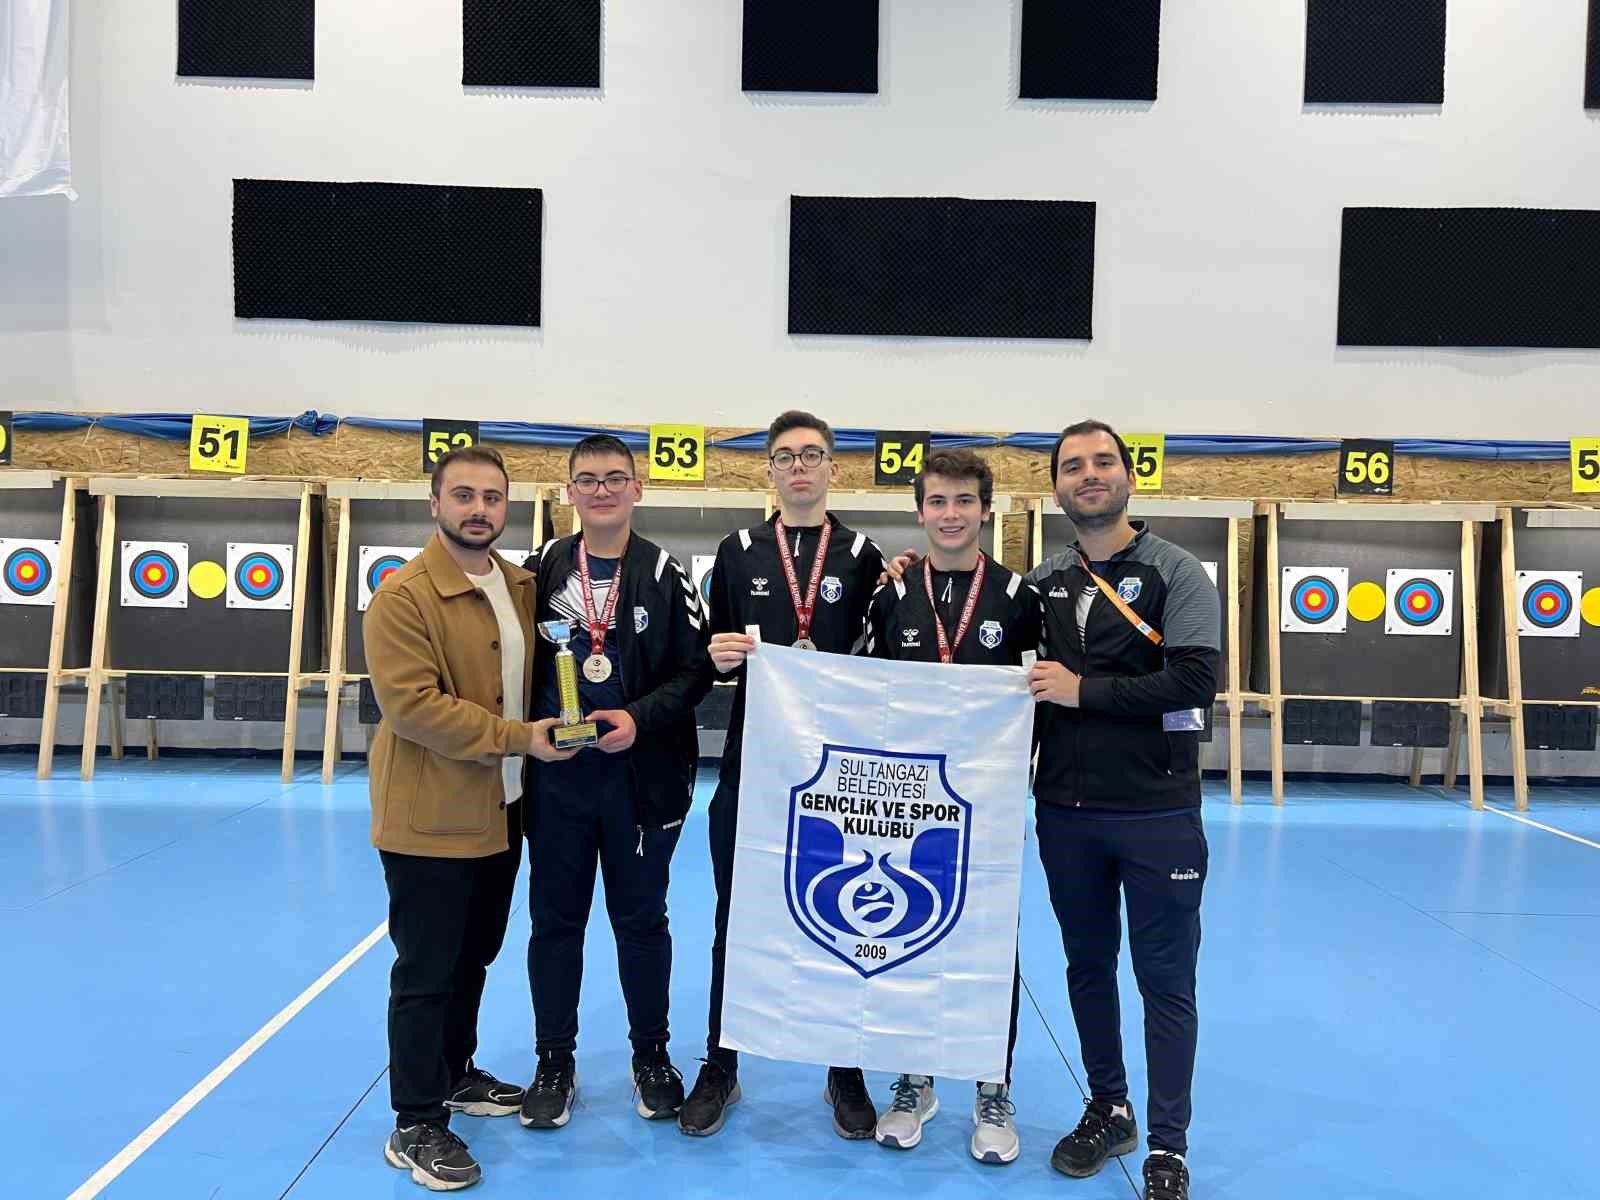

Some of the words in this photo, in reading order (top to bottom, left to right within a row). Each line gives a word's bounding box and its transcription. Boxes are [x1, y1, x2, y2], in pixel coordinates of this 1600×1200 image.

[198, 427, 239, 460] 51
[655, 436, 698, 468] 53
[880, 442, 923, 474] 54
[1128, 446, 1157, 477] 5
[1345, 451, 1389, 484] 56
[882, 801, 906, 819] VE
[909, 803, 961, 822] SPOR
[843, 817, 915, 839] KULÜBÜ
[855, 943, 887, 960] 2009
